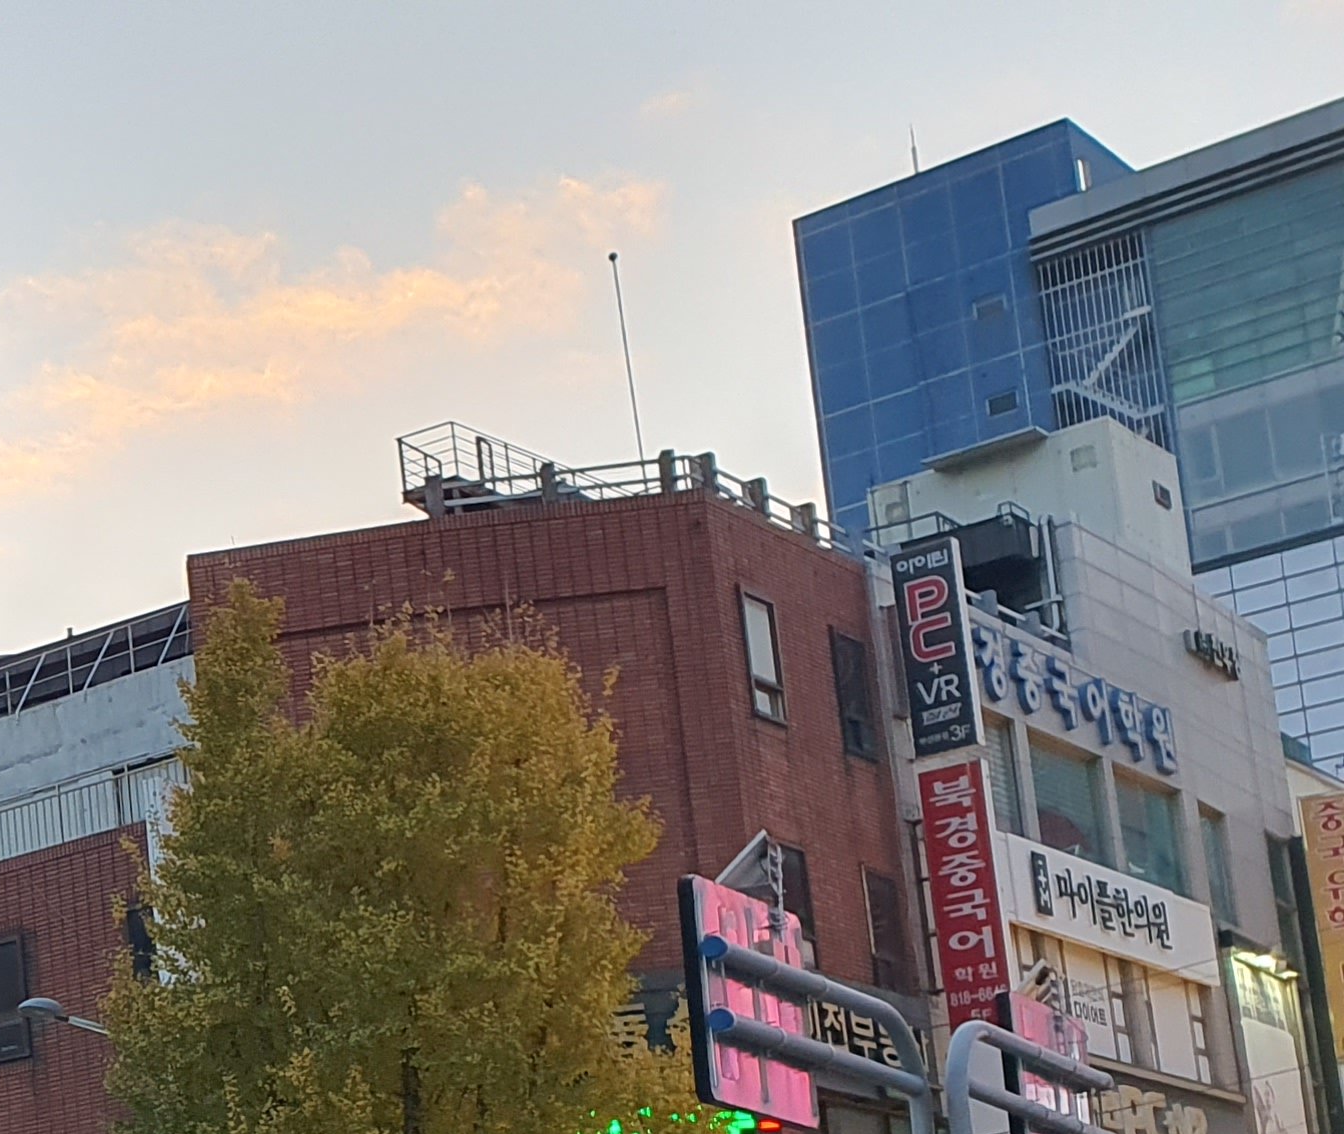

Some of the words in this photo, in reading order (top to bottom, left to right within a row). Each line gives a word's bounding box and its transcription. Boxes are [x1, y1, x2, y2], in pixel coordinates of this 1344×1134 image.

[903, 574, 956, 663] PC
[916, 673, 962, 705] VR
[949, 724, 971, 742] 3F
[928, 774, 996, 959] 북경중국어
[1055, 867, 1173, 950] 마이플한의원
[955, 961, 998, 982] 학원
